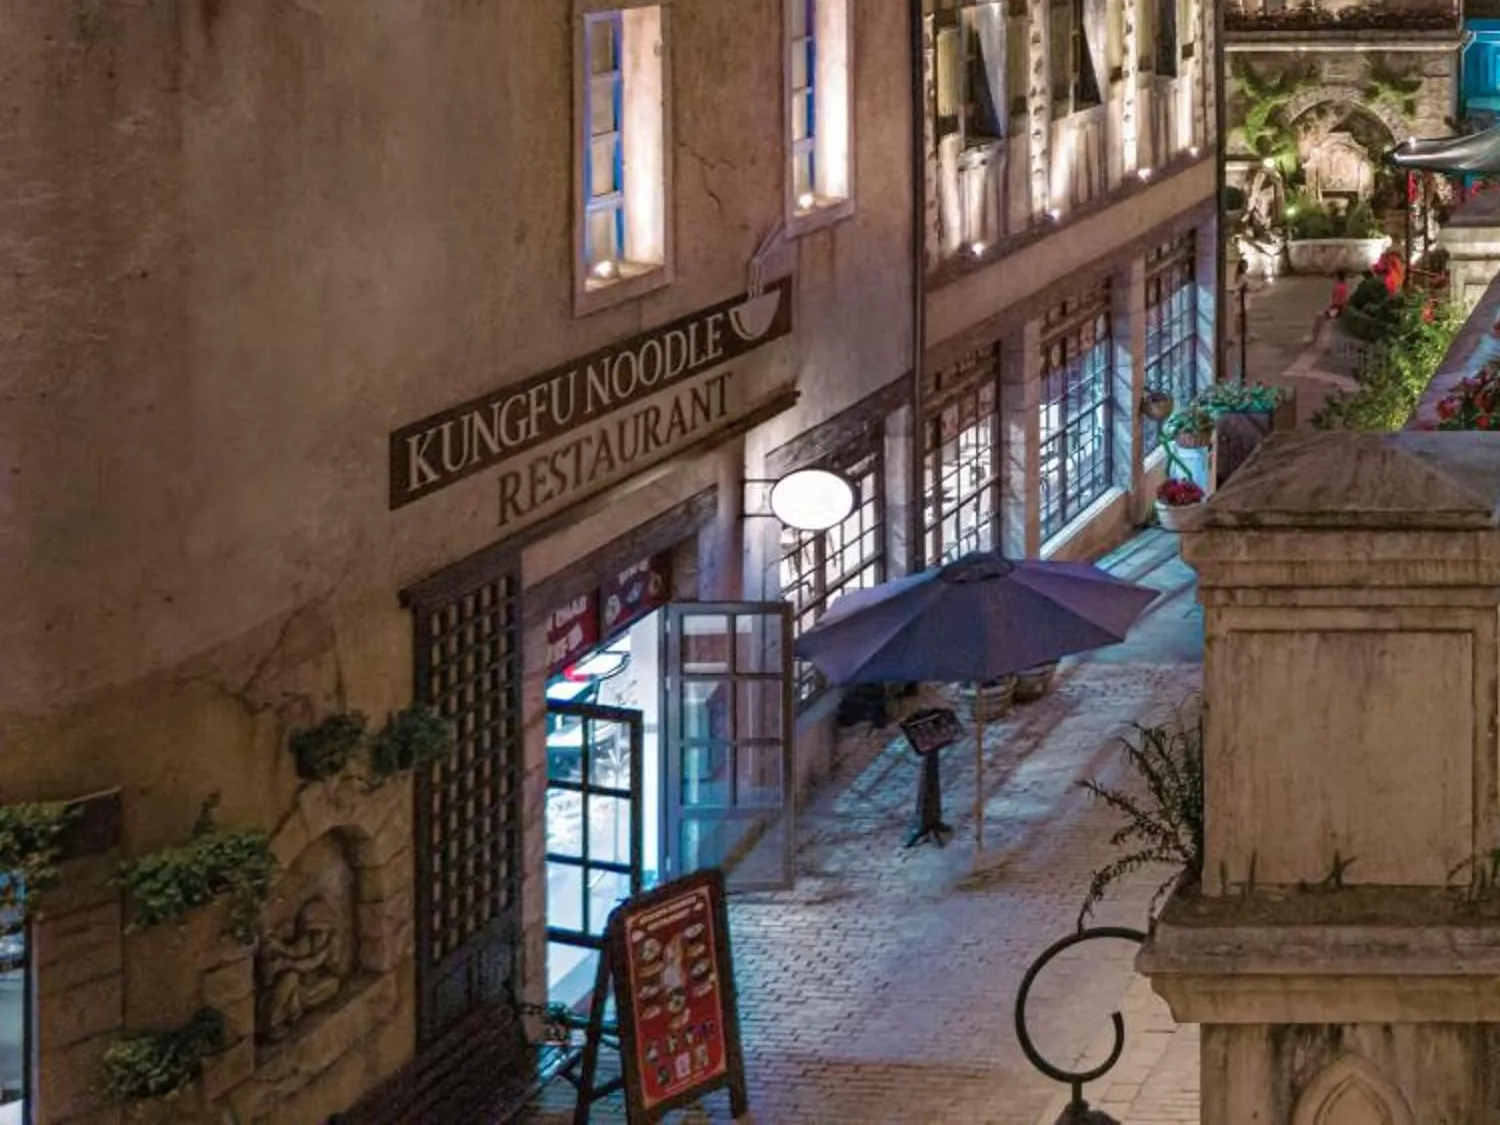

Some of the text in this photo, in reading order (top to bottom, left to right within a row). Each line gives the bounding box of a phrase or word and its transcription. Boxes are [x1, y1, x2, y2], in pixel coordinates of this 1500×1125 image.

[407, 312, 725, 492] KUNGFU NOODLE
[498, 373, 733, 525] RESTAURANT
